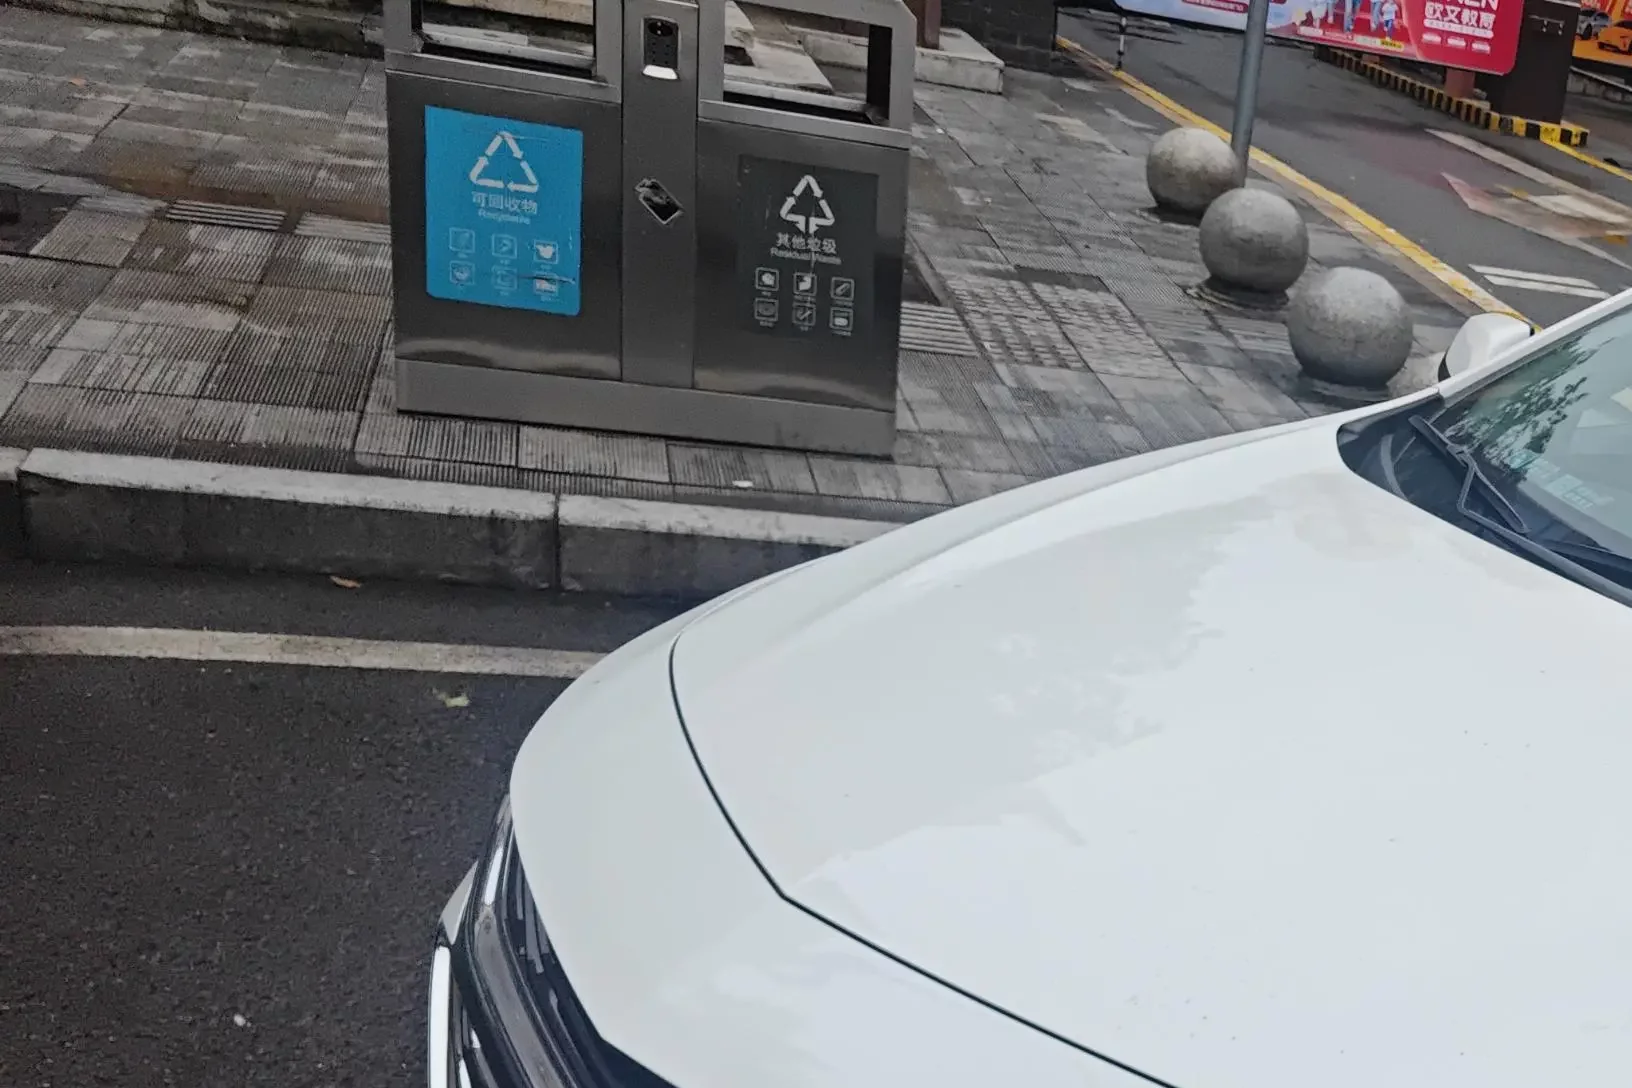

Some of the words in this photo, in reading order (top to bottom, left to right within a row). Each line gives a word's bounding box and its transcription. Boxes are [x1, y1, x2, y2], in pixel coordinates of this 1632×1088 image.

[1424, 2, 1497, 30] 欧文教育
[471, 190, 538, 215] 可回收物
[776, 232, 837, 255] 其他垃圾
